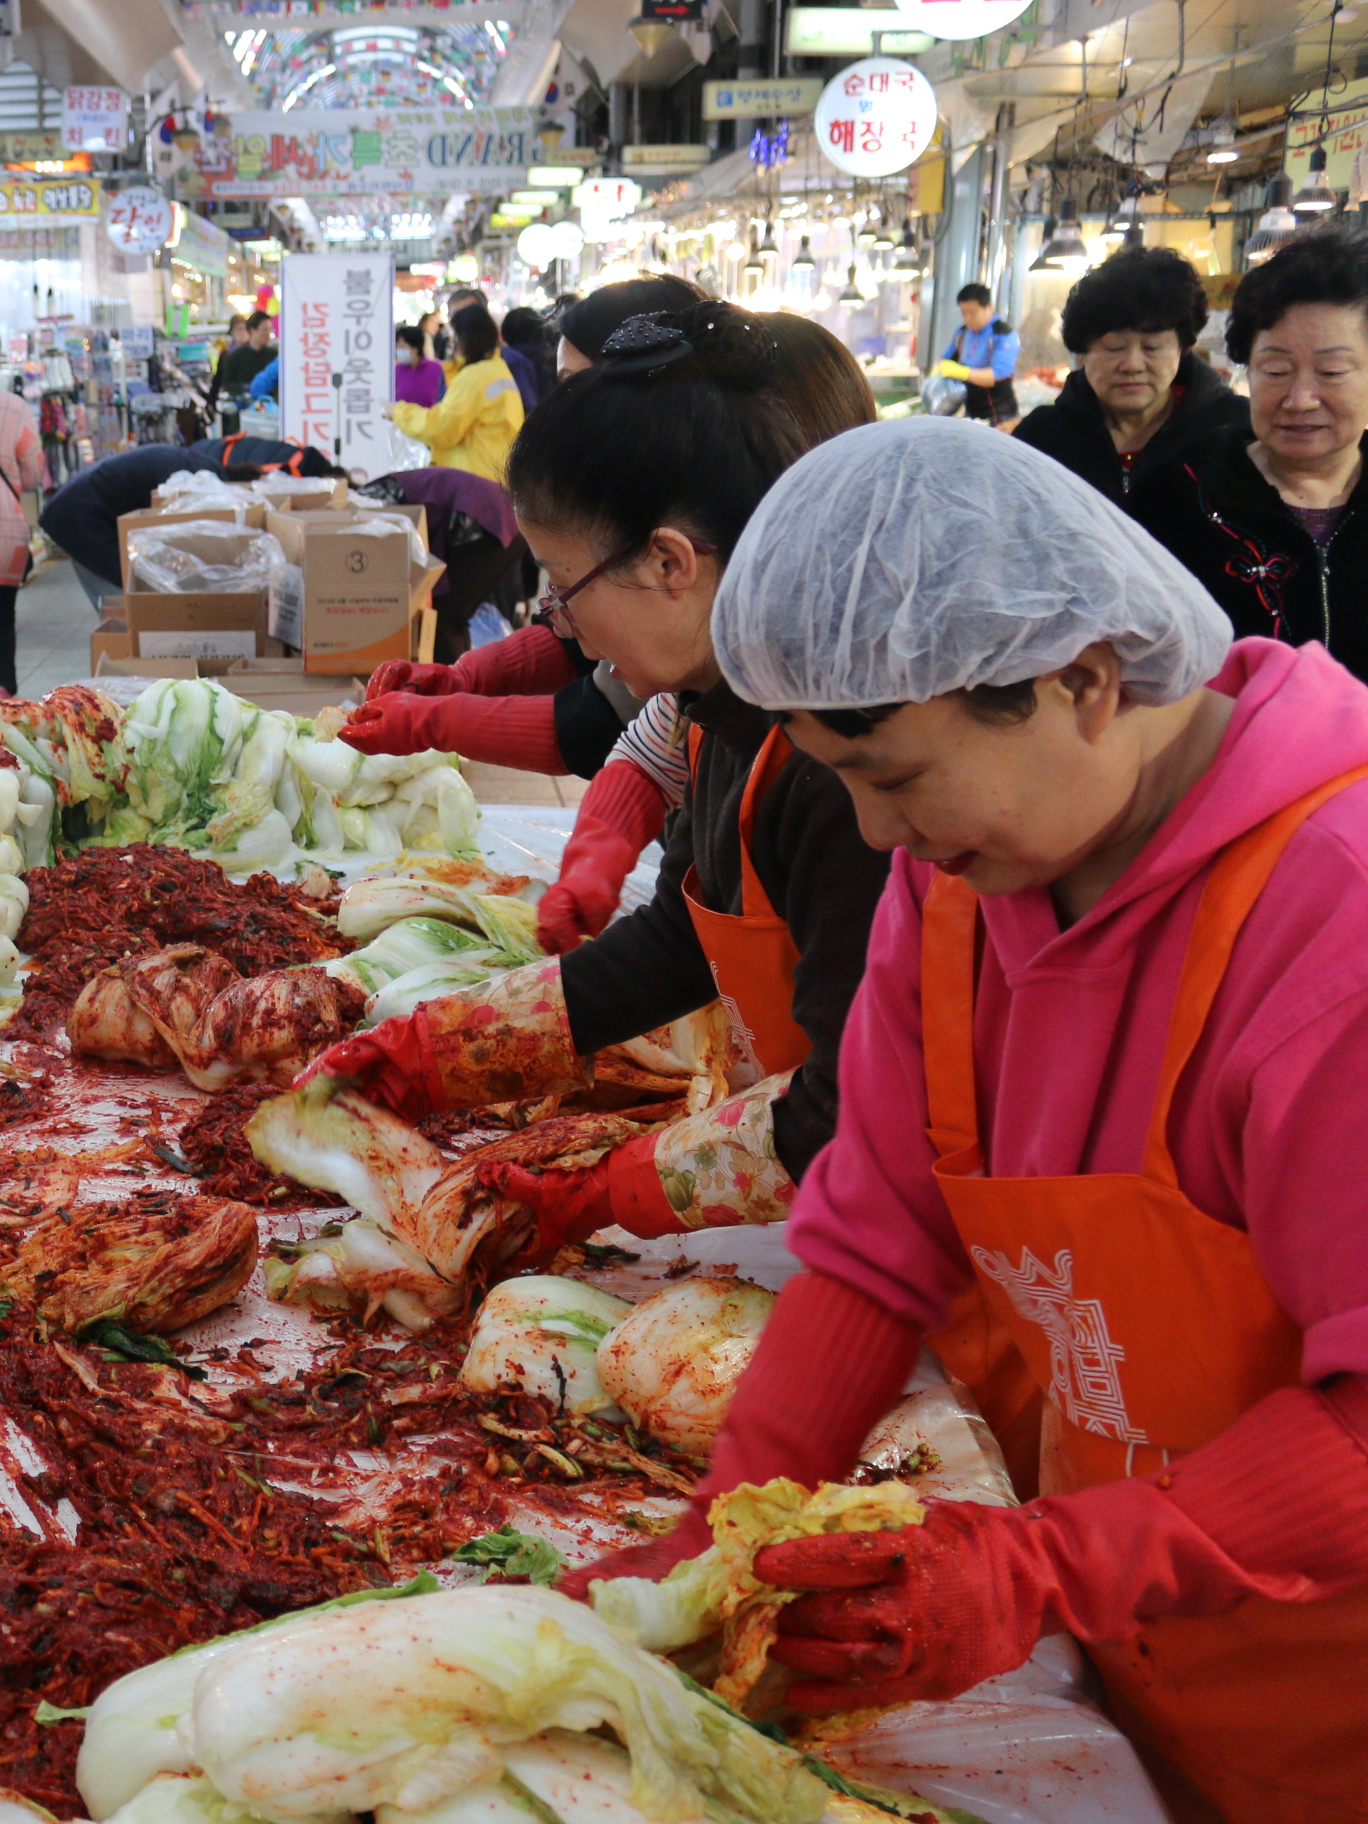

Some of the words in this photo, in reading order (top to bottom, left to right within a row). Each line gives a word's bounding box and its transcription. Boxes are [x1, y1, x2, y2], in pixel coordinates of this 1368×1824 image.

[843, 70, 915, 97] 순대국
[67, 89, 121, 112] 닭강정
[829, 119, 918, 153] 해장국
